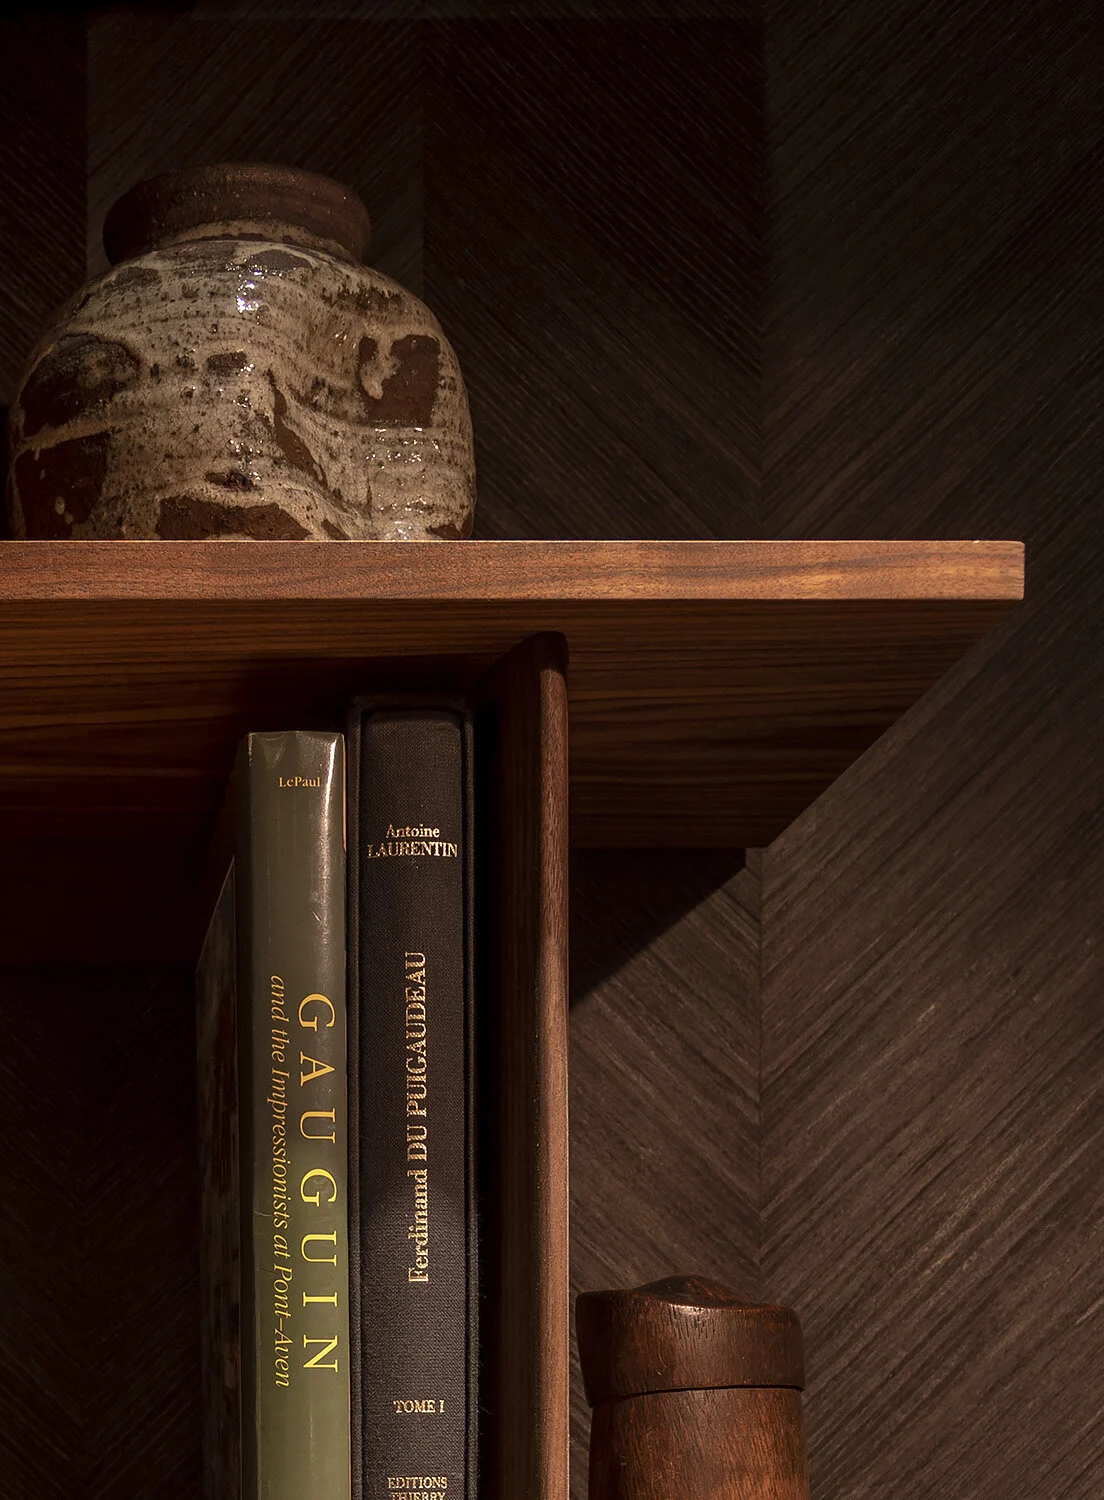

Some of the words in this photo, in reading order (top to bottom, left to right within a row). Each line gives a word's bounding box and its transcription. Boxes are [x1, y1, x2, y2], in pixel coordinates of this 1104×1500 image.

[278, 775, 321, 789] LePaul
[366, 841, 458, 859] LAURENTIN
[385, 824, 441, 840] Antoine
[269, 974, 289, 1022] and
[270, 1025, 290, 1062] the
[404, 951, 427, 1117] PUIGAUDEAU
[266, 1068, 292, 1232] Impressionists
[405, 1125, 428, 1161] DU
[298, 992, 338, 1373] GAUGUIN
[406, 1168, 429, 1283] Ferdinand
[272, 1234, 291, 1259] at
[393, 1399, 435, 1414] TOME
[438, 1399, 446, 1414] I
[387, 1476, 448, 1489] EDITIONS
